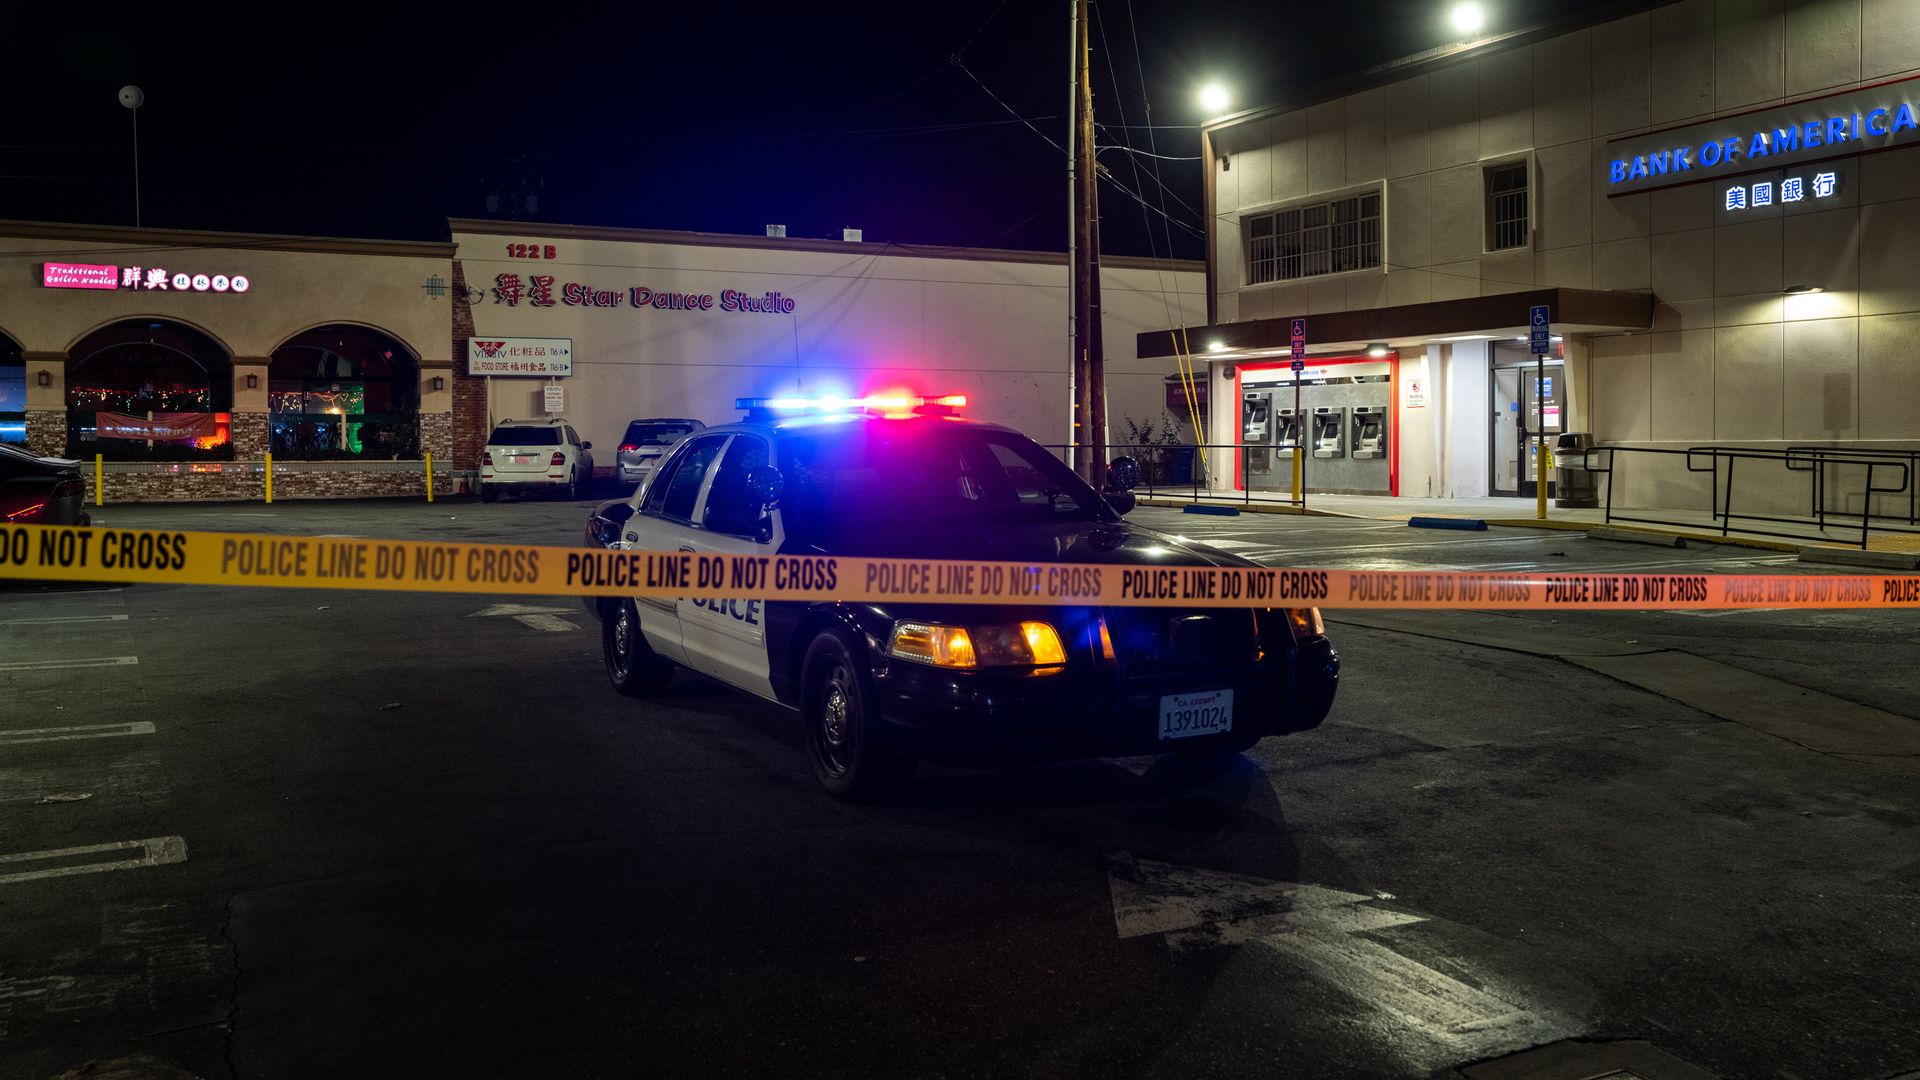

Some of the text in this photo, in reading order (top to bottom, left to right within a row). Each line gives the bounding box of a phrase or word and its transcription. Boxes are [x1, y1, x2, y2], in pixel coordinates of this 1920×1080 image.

[1610, 103, 1918, 183] BANK OF AMERICA
[1725, 172, 1836, 210] 美國銀行
[506, 243, 557, 260] 122 B
[50, 267, 108, 276] Traditional
[81, 277, 117, 285] Noodles
[497, 273, 556, 307] 舞星
[564, 282, 796, 313] Star Dance Studio
[559, 348, 564, 356] A
[481, 362, 494, 371] FOOD
[495, 362, 509, 371] STORE
[550, 363, 558, 371] 116
[39, 529, 93, 567] NOT
[101, 531, 186, 570] CROSS
[221, 540, 540, 583] POLICE LINE DO NOT CROSS
[566, 553, 838, 592] POLICE LINE DO NOT CROSS
[865, 562, 1102, 598] POLICE LINE DO NOT CROSS
[1121, 570, 1328, 600] POLICE LINE DO NOT CROSS
[1349, 574, 1531, 602] POLICE LINE DO NOT CROSS
[1545, 577, 1707, 602] POLICE LINE DO NOT CROSS
[1724, 578, 1871, 602] POLICE LINE DO NOT CROSS
[1883, 579, 1920, 602] POLICE
[679, 597, 761, 625] LICE
[1190, 697, 1216, 706] EXEMPT
[1164, 705, 1228, 733] 1391024
